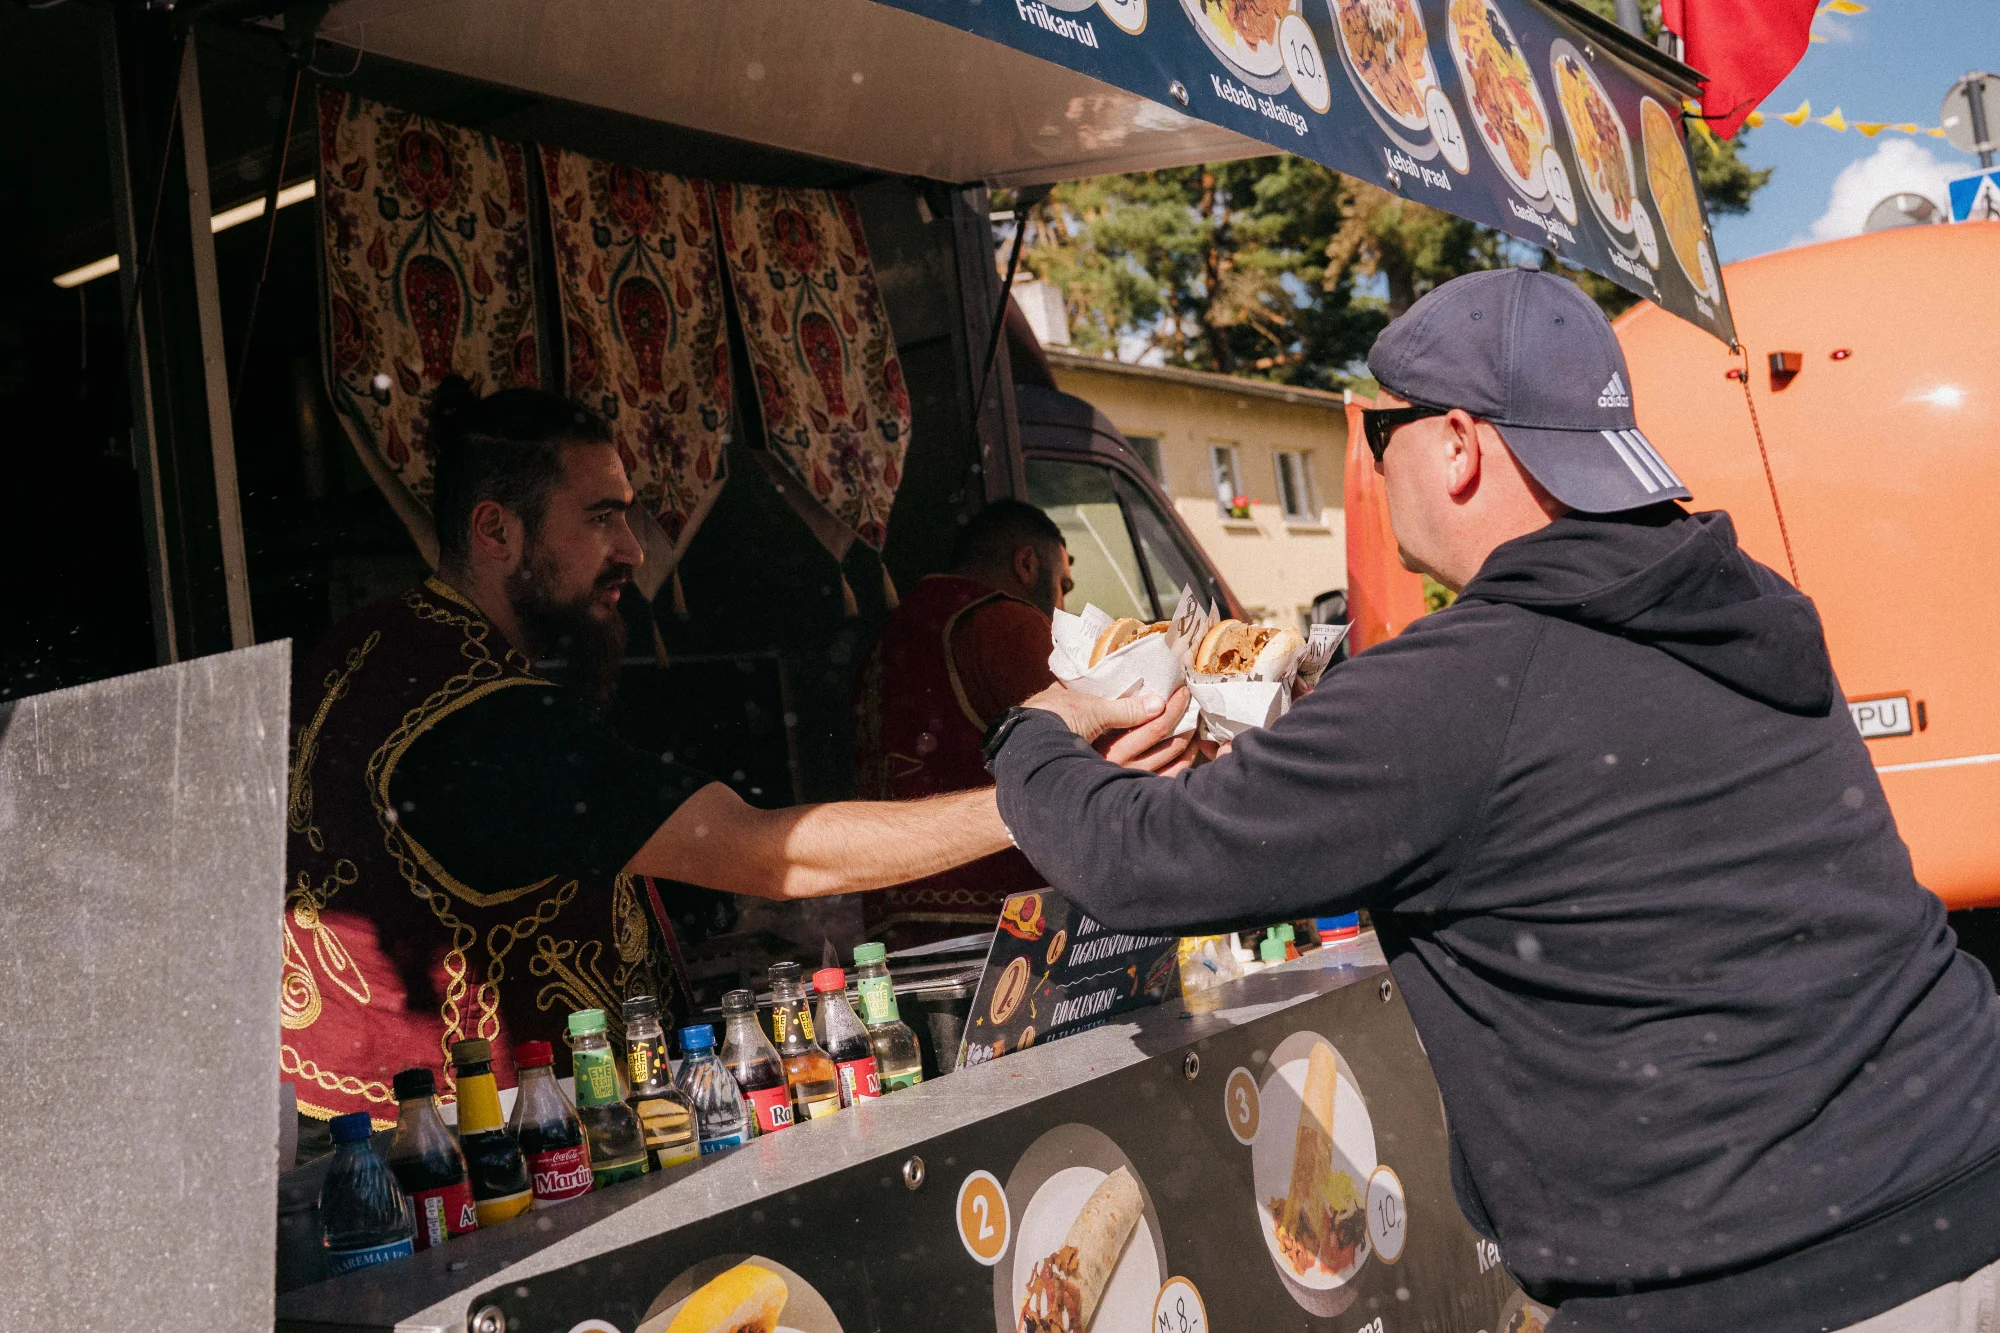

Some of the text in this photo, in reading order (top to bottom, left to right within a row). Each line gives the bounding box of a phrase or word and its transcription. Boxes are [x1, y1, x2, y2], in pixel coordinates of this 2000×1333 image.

[1210, 73, 1309, 136] Kebab salatiga
[1383, 146, 1452, 191] Kebab praad
[1597, 395, 1629, 408] adidas
[1850, 704, 1897, 731] PU
[589, 1065, 611, 1079] EHE
[1235, 1086, 1251, 1124] 3
[972, 1194, 995, 1241] 2
